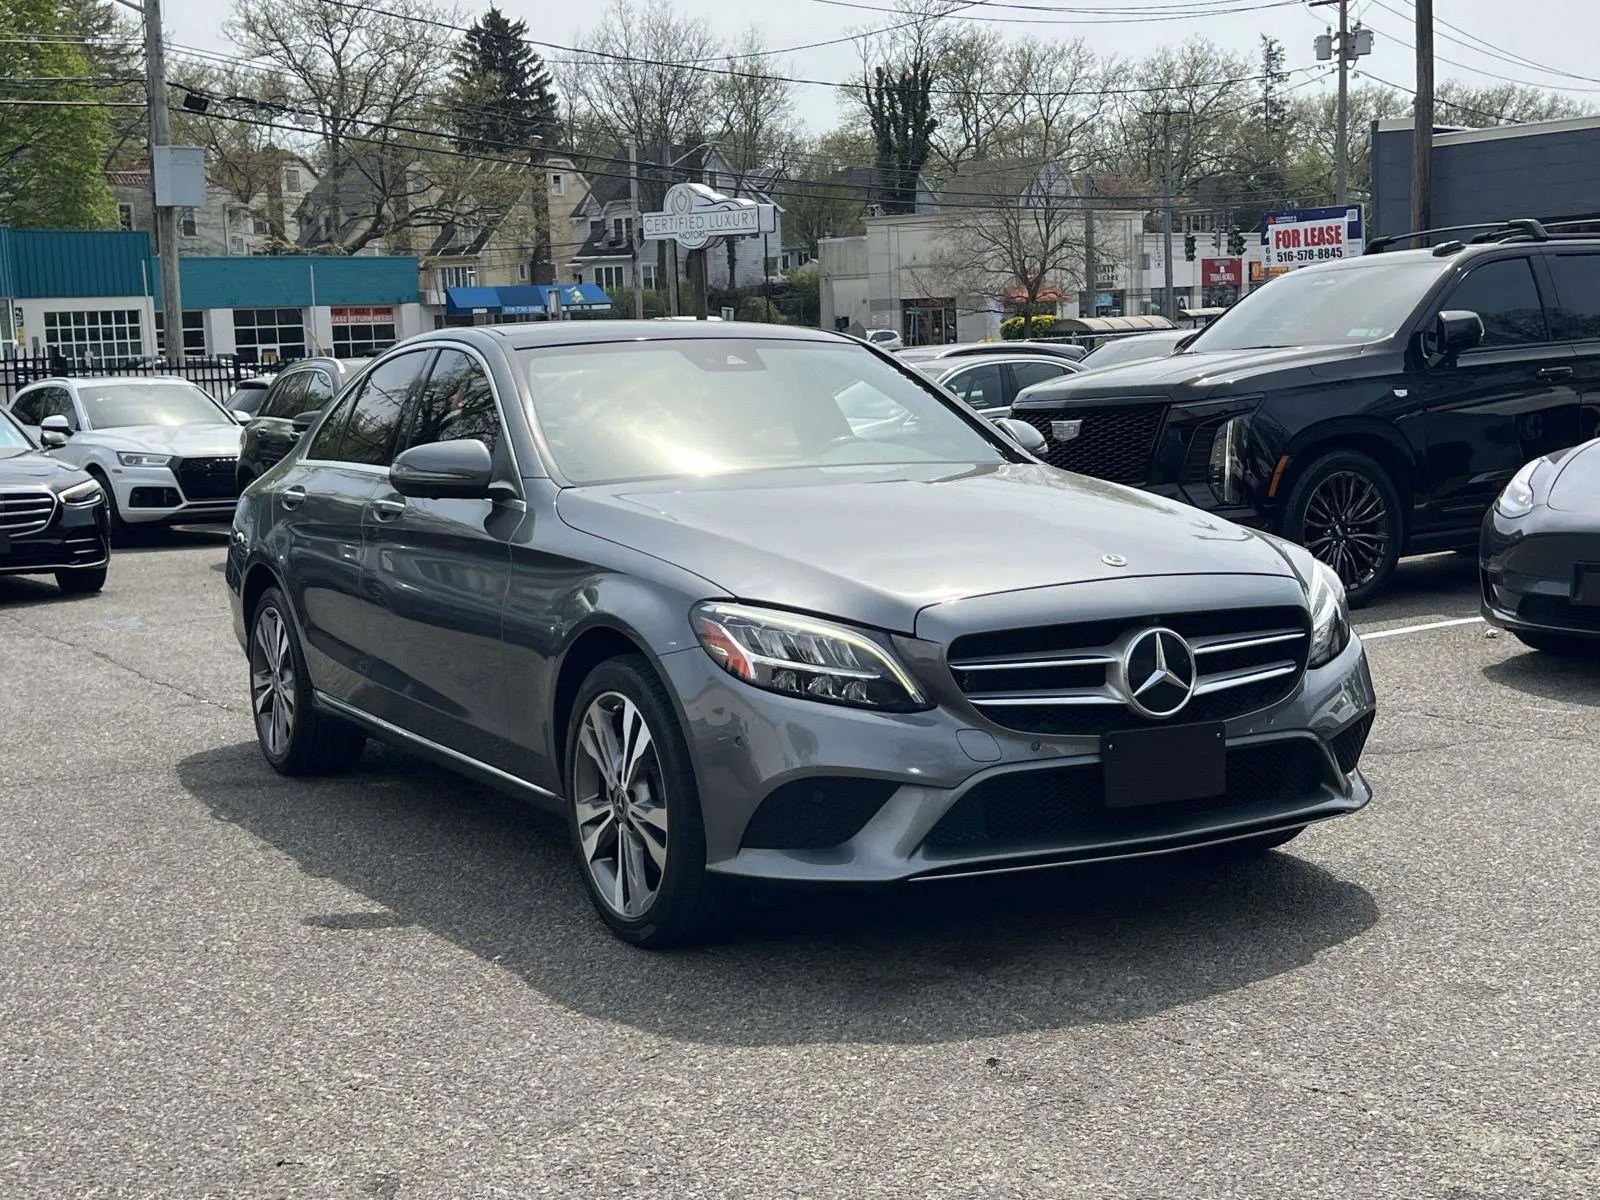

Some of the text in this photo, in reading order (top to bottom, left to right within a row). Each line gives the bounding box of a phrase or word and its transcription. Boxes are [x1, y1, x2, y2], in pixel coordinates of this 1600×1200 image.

[644, 211, 756, 232] CERTIFIED LUXURY
[679, 231, 707, 240] MOTORS
[1275, 225, 1342, 249] FOR LEASE
[1277, 247, 1343, 262] 516-578-8845
